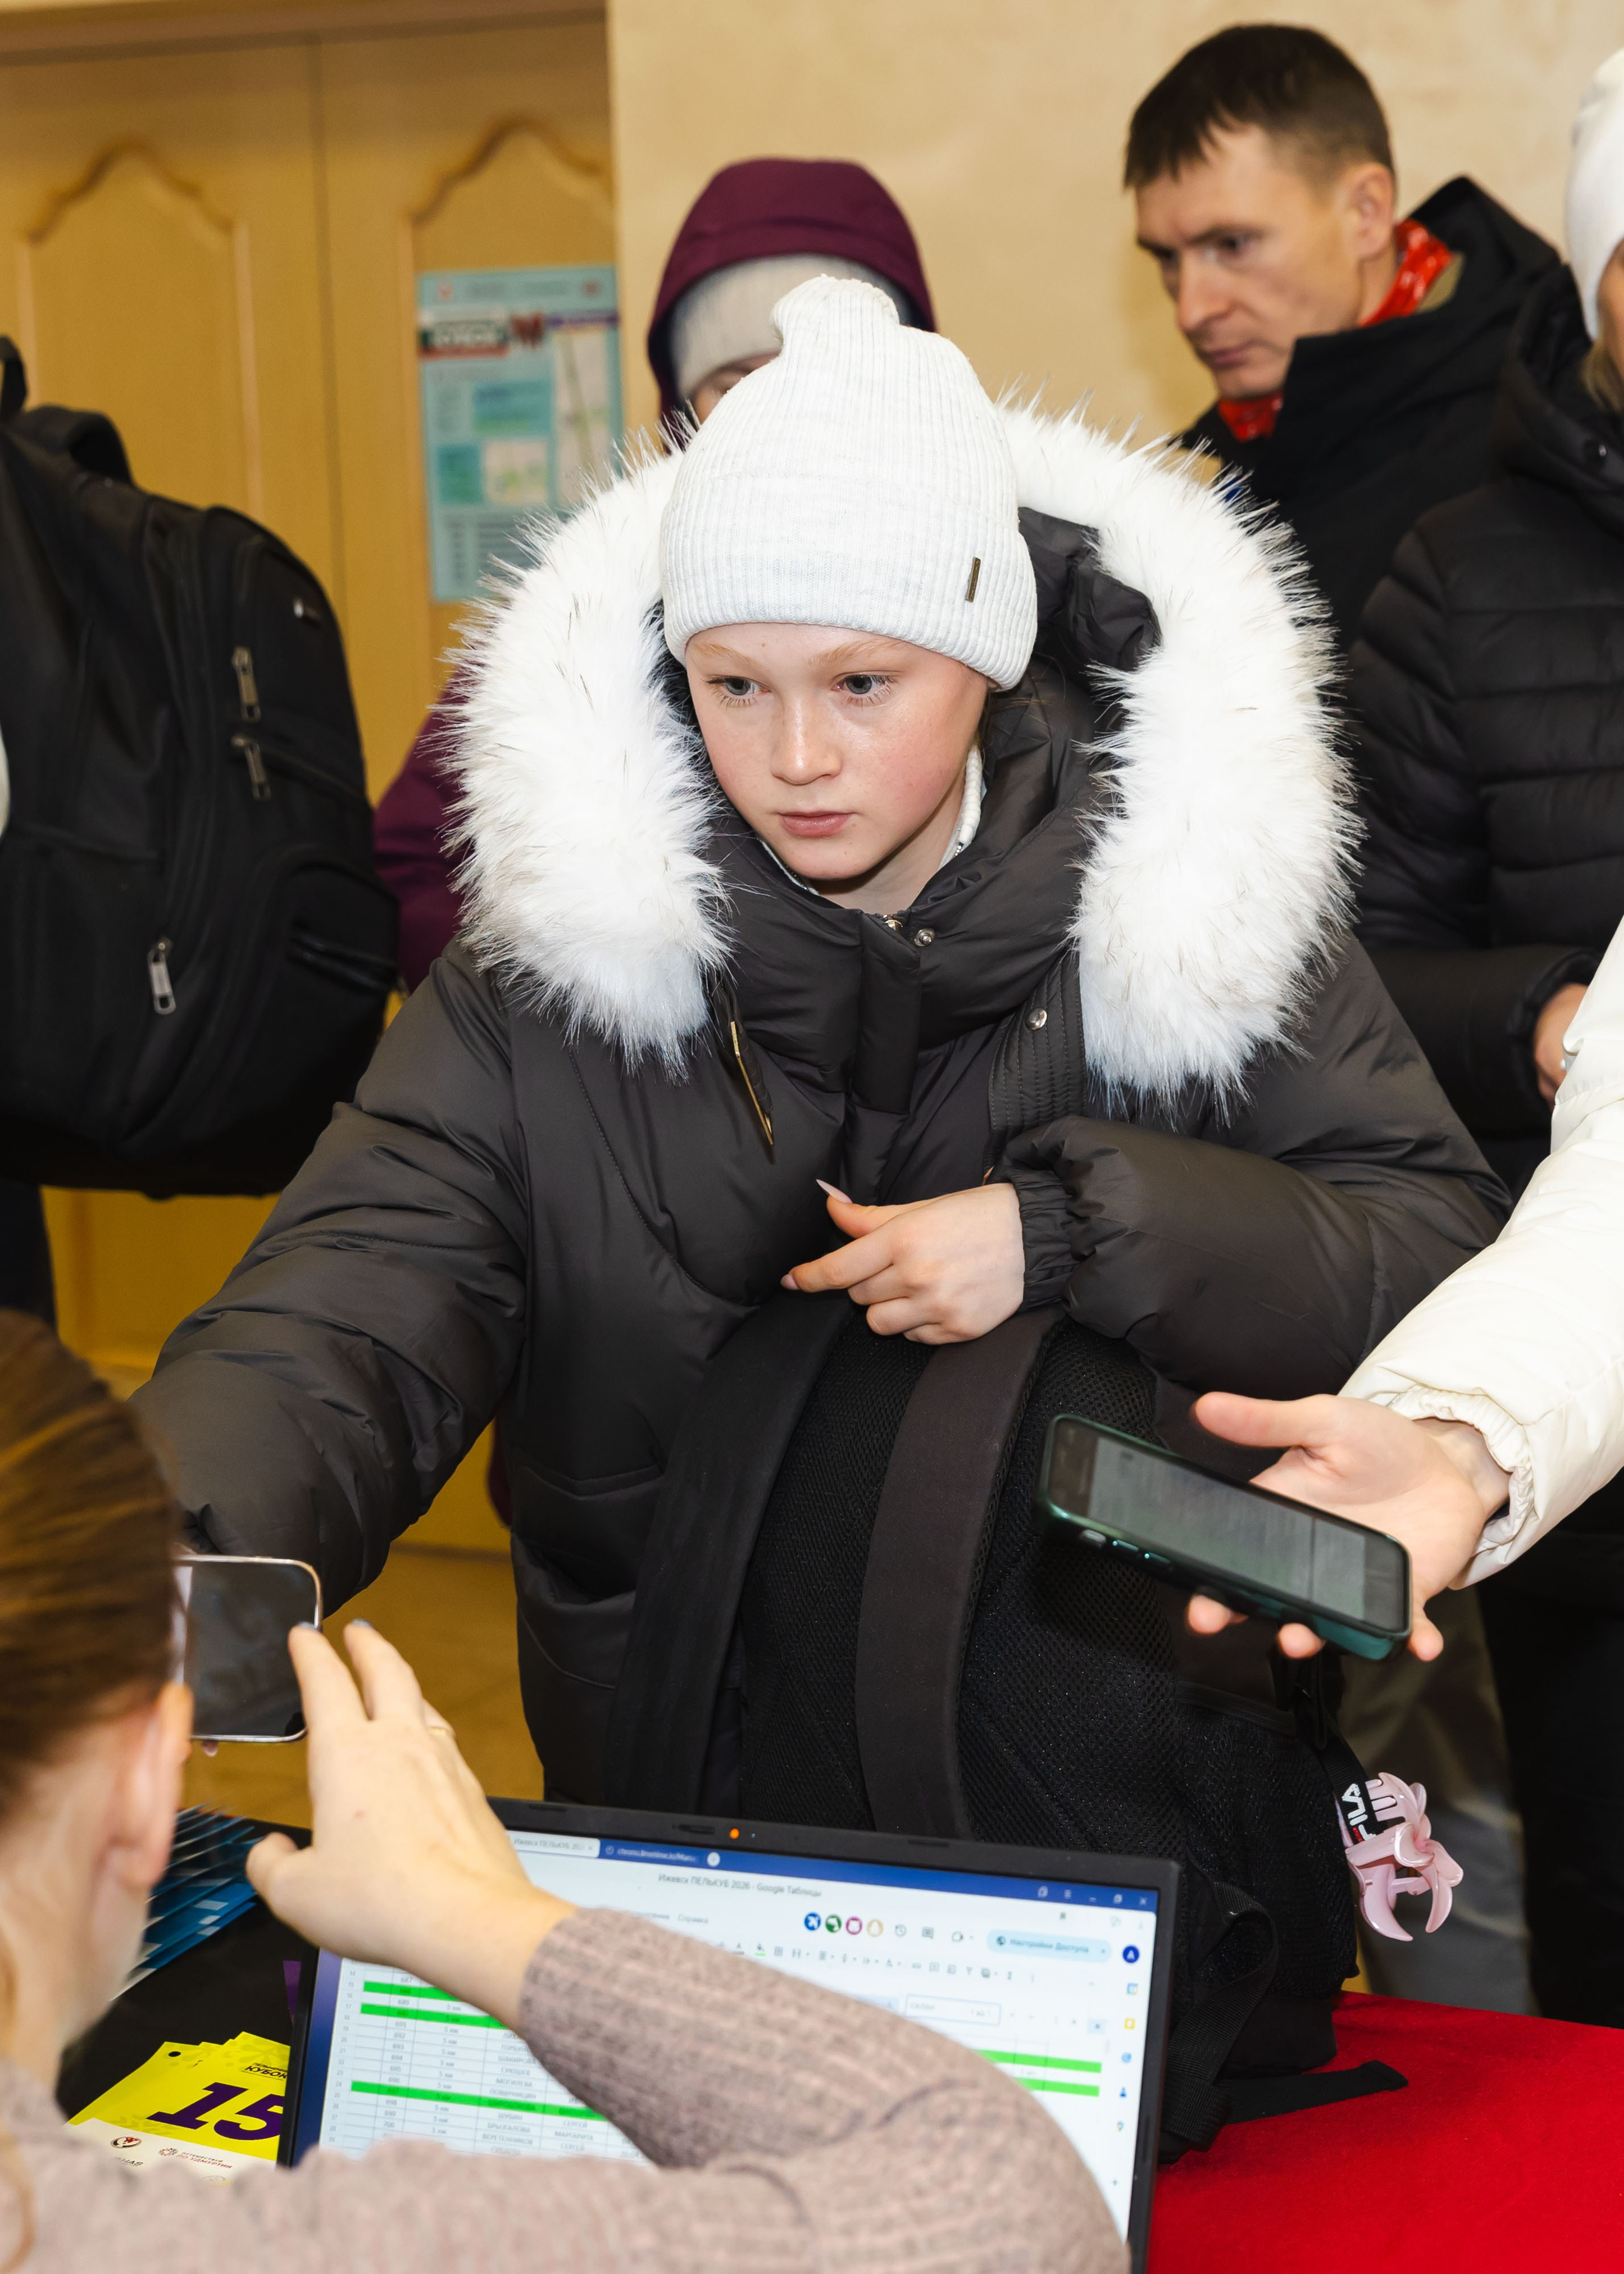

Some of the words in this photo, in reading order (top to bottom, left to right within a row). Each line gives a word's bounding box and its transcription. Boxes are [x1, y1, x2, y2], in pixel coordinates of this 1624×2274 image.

[658, 1873, 689, 1884] Ижевск
[691, 1876, 730, 1888] ПЕЛЬКУБ
[731, 1880, 750, 1890] 2026
[757, 1883, 785, 1895] Google
[787, 1885, 822, 1897] Таблицы
[245, 2065, 287, 2079] КУБОК
[145, 2082, 285, 2141] 15
[190, 2157, 233, 2169] УДМУРТИИ
